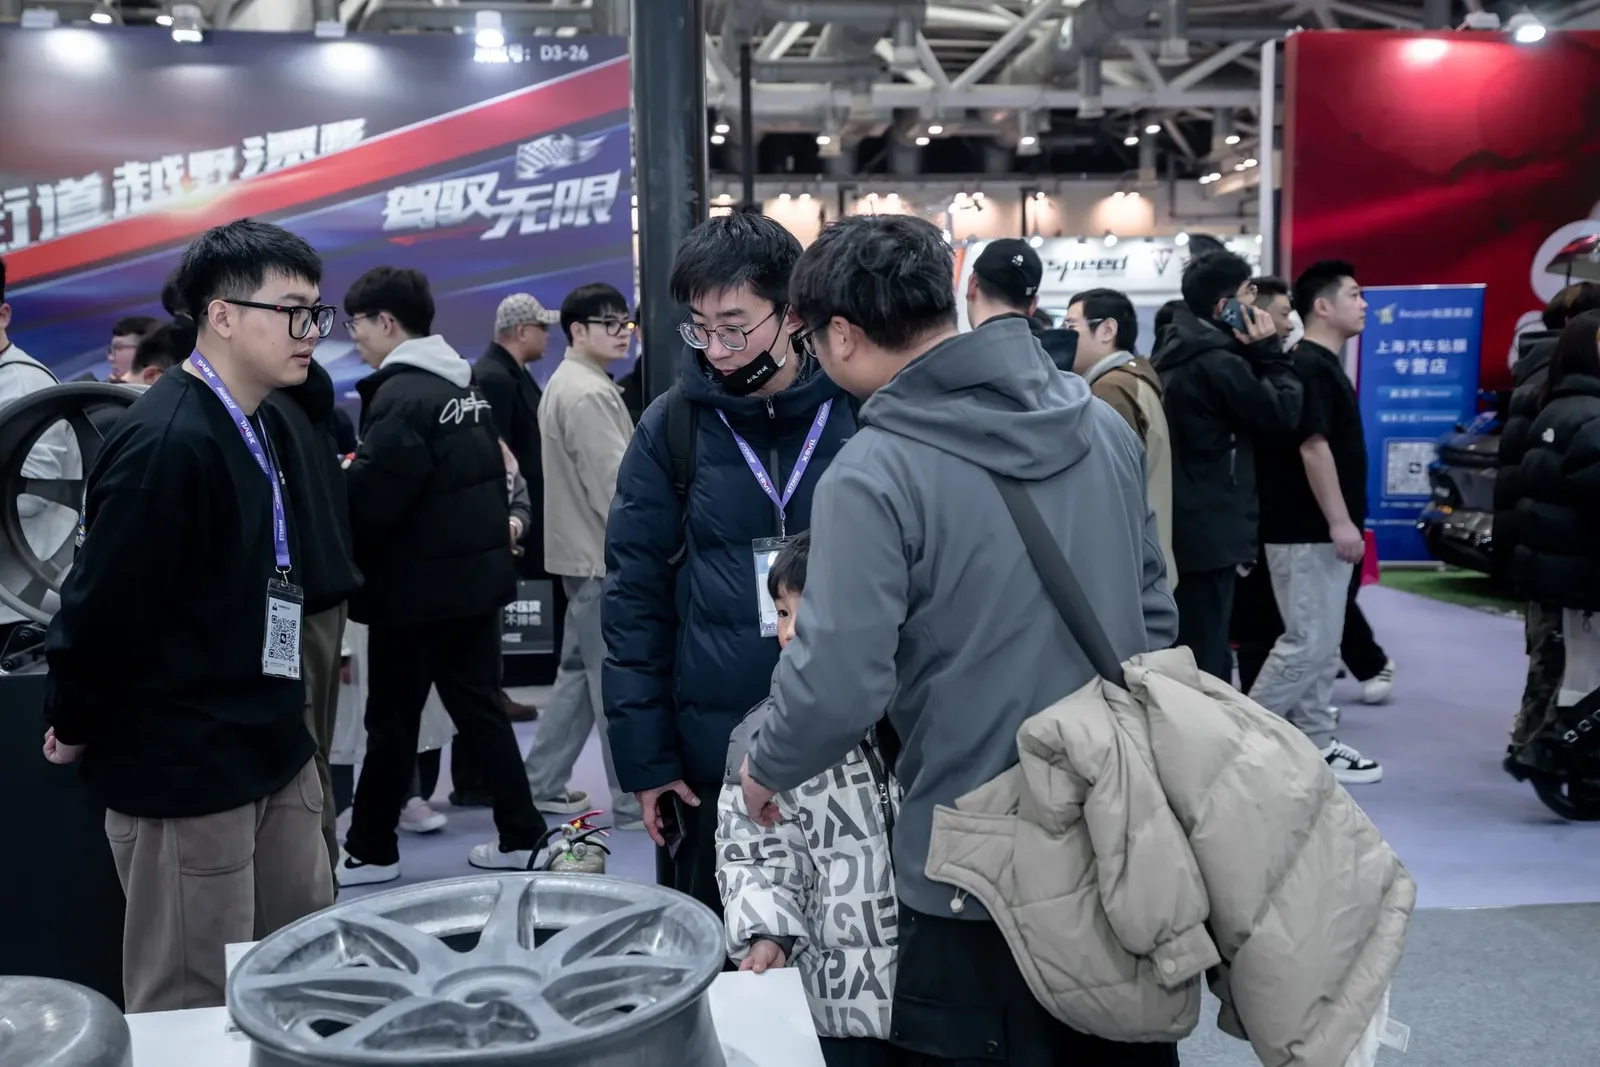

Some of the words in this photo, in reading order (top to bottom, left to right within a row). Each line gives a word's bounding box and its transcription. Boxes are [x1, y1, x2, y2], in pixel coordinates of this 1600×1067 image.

[540, 45, 588, 61] D3-26
[381, 168, 621, 241] 驾驭无限
